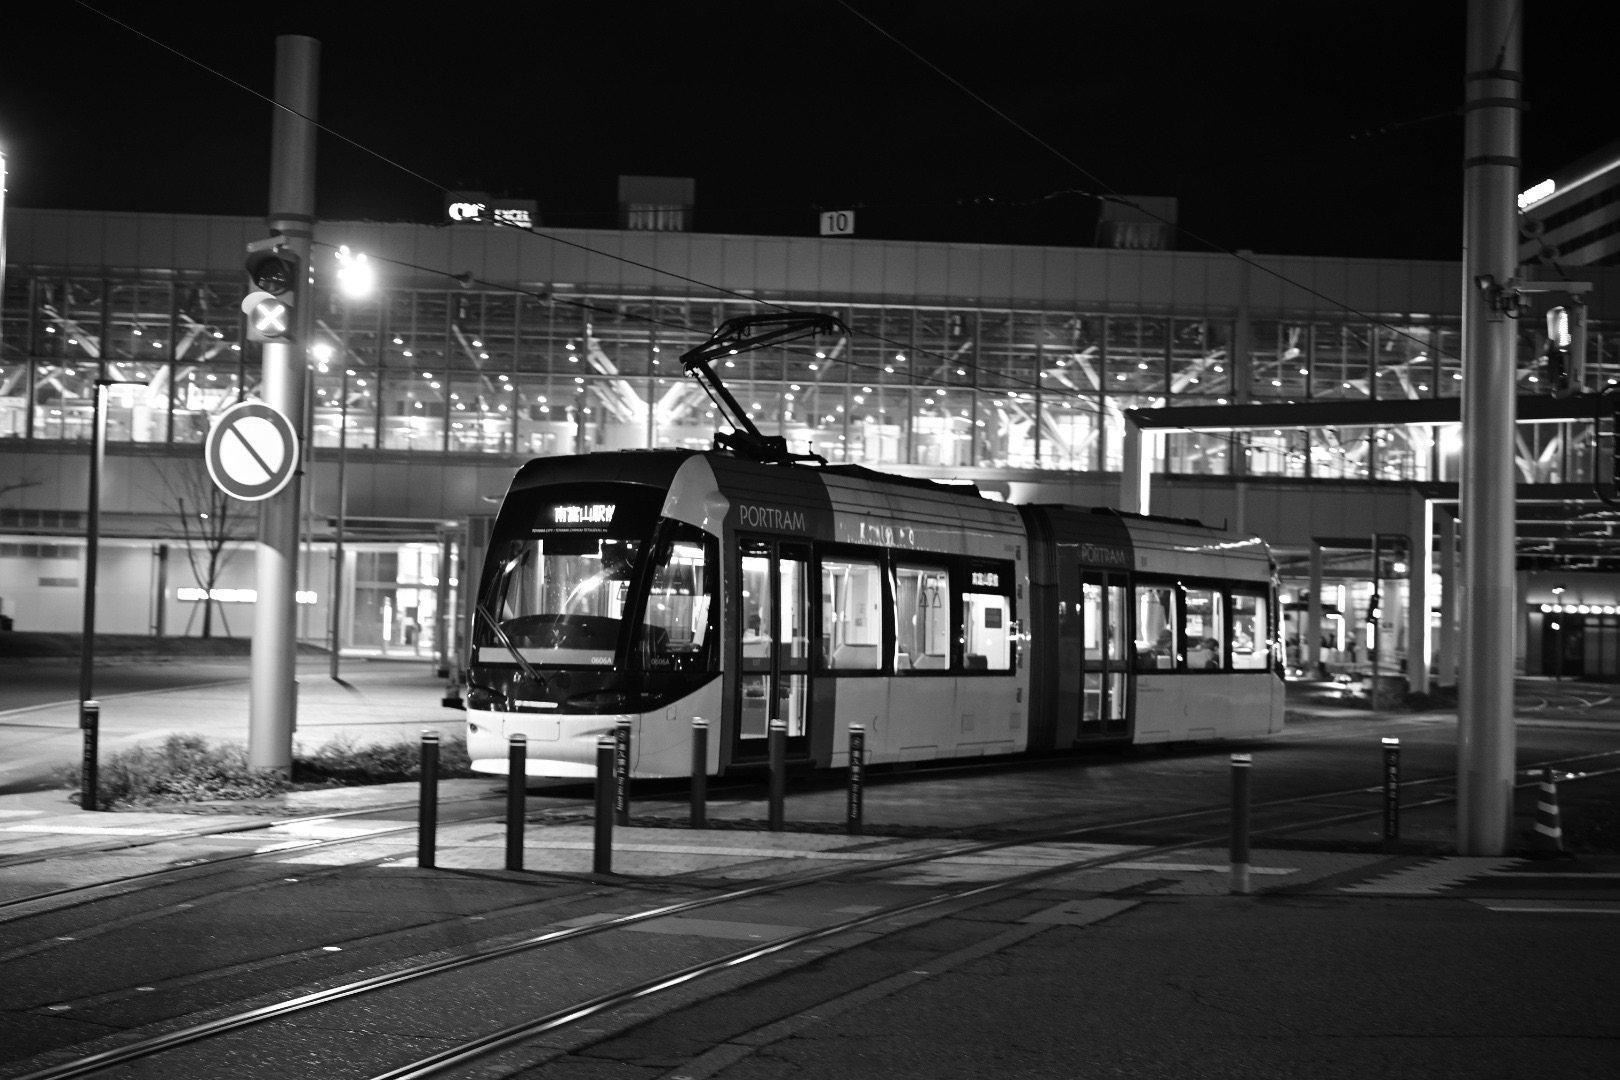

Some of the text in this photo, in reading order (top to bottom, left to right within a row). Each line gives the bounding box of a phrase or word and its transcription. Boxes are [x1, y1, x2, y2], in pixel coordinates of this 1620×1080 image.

[827, 213, 848, 232] 10
[740, 505, 805, 532] PORTRAM
[1081, 546, 1125, 565] PORTRAM
[591, 656, 612, 664] 0606A
